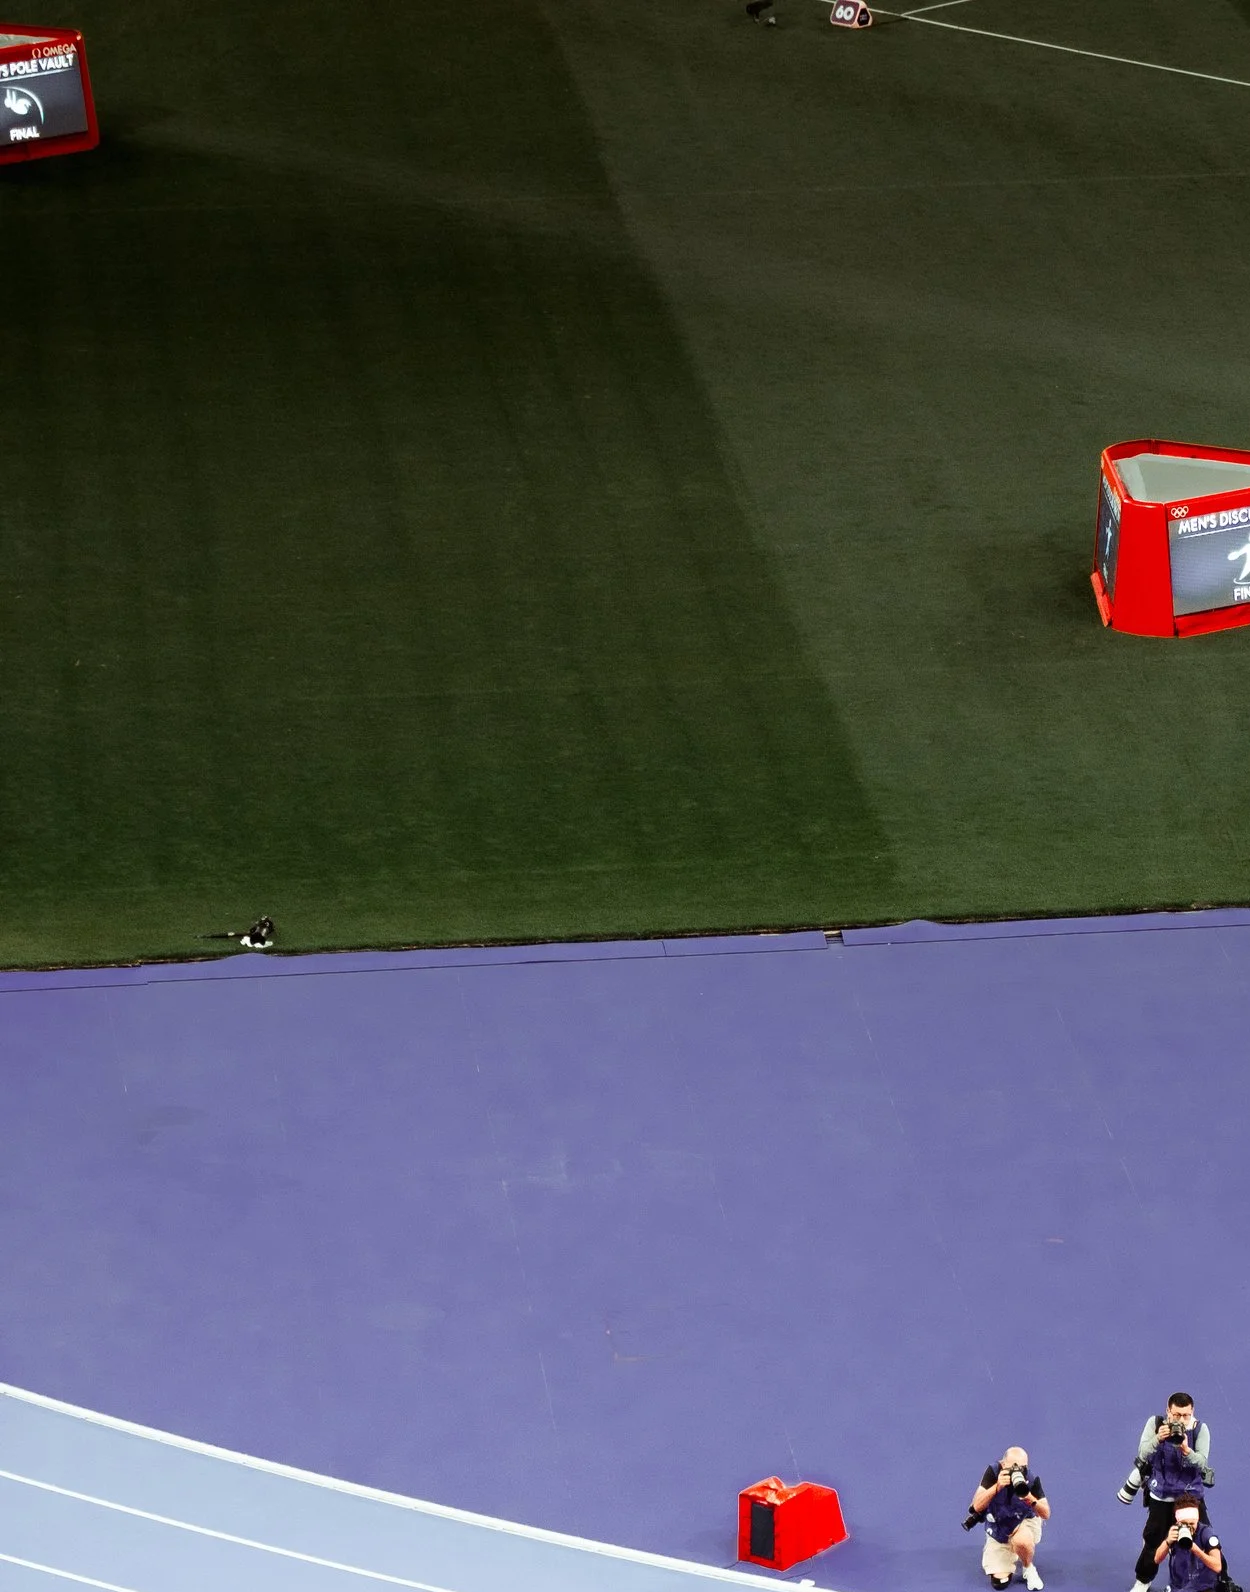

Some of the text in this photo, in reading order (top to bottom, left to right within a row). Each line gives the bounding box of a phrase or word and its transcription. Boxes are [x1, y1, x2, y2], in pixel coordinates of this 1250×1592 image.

[835, 5, 854, 20] 60
[43, 43, 76, 57] OMEGA
[9, 59, 39, 76] POLE
[38, 53, 74, 71] VAULT
[9, 126, 40, 141] FINAL
[1178, 514, 1217, 534] MEN'S
